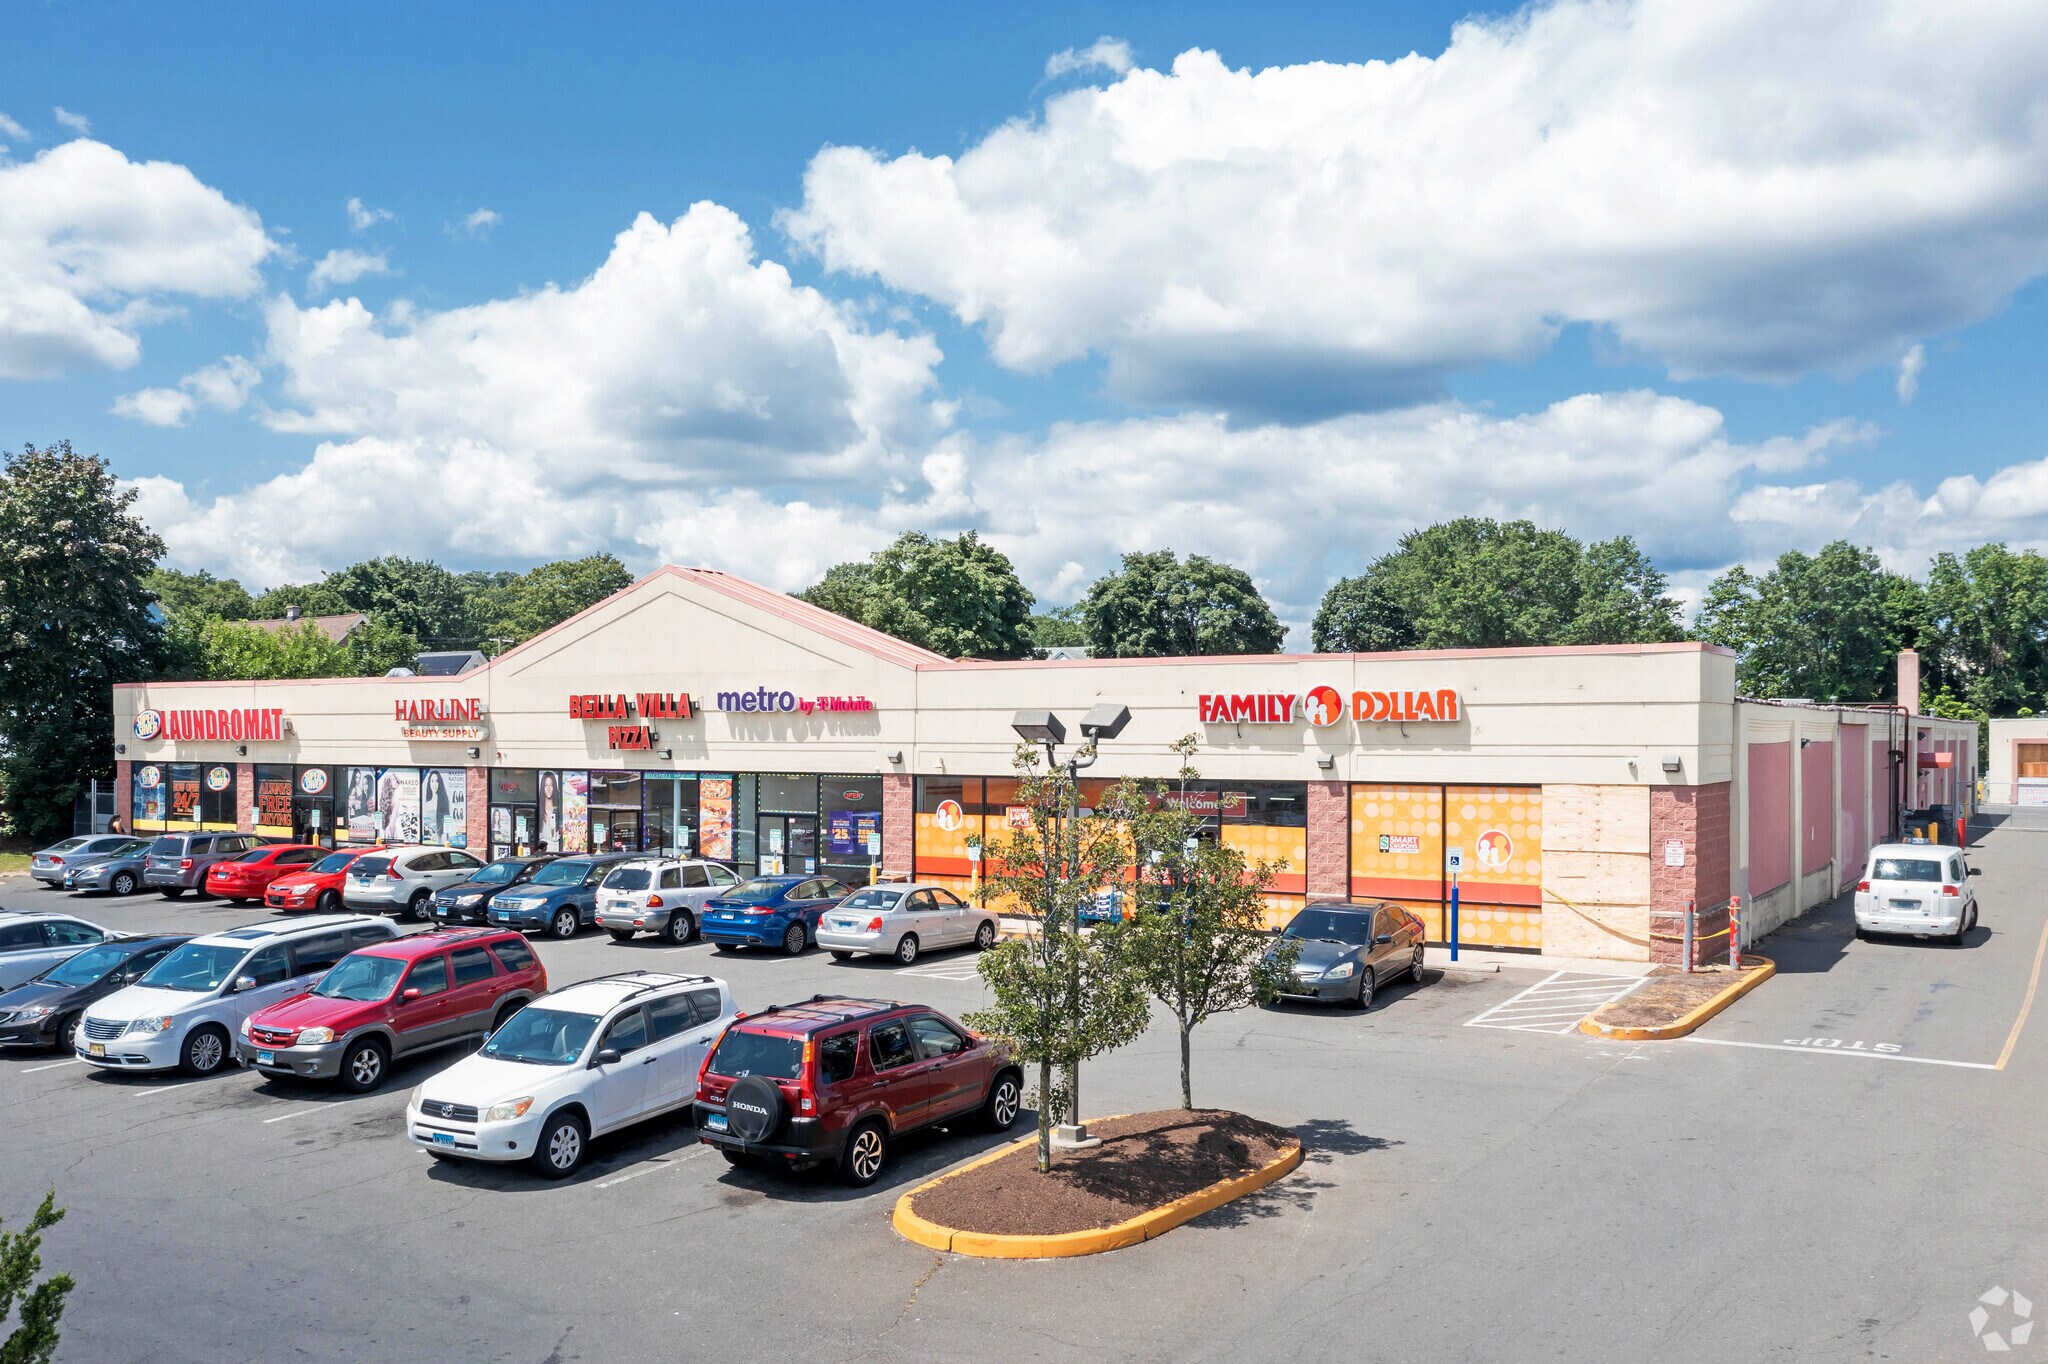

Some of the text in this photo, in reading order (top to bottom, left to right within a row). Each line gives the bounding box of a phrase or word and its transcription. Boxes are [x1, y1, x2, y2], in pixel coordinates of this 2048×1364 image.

[569, 693, 691, 719] BELLA VILLA
[717, 686, 795, 712] metro
[799, 697, 815, 716] by
[1199, 694, 1295, 722] FAMILY
[1352, 690, 1457, 721] DOLLAR
[395, 698, 480, 721] HAIRLINE
[137, 712, 155, 726] SUPER
[161, 709, 283, 740] LAUNDROMAT
[138, 721, 158, 737] SAVER
[403, 728, 479, 738] BEAUTY SUPPLY
[608, 726, 651, 750] PIZZA
[259, 782, 292, 795] ALWAYS
[173, 791, 199, 808] 24/7
[259, 795, 292, 813] FREE
[259, 813, 292, 826] DRYING
[1010, 812, 1029, 820] LOW
[1390, 836, 1418, 844] SMART
[1782, 1037, 1903, 1053] STOP
[732, 1101, 768, 1115] HONDA
